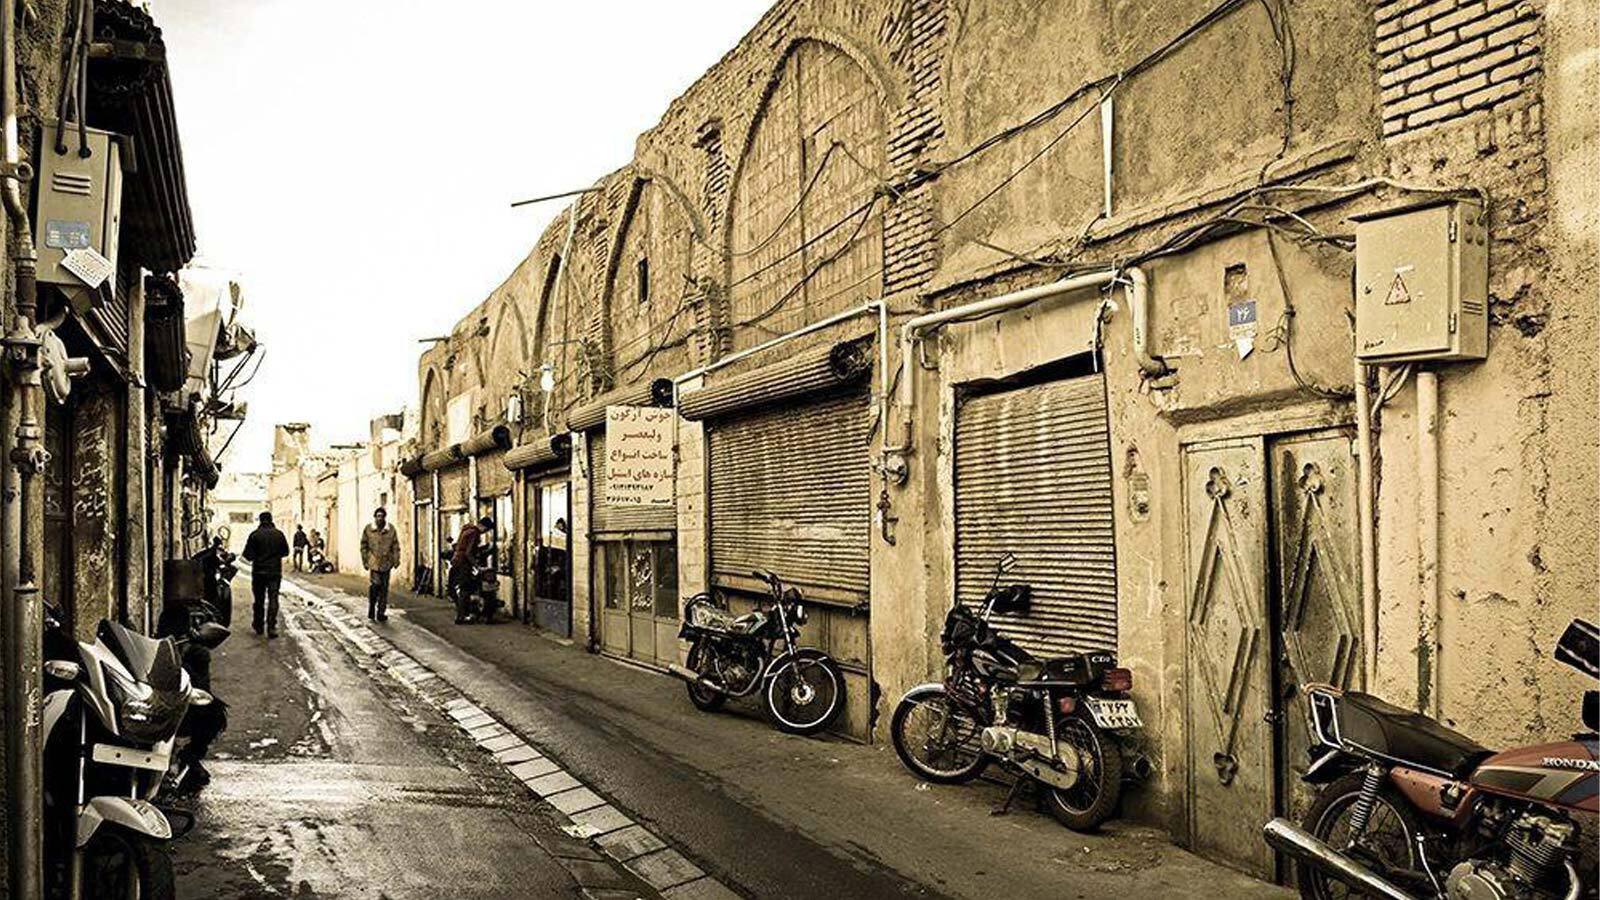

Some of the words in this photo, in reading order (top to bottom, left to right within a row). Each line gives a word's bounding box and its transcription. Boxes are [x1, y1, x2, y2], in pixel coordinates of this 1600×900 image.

[609, 449, 640, 462] انواع
[642, 450, 668, 460] ساخت
[1542, 757, 1599, 769] HONDA
